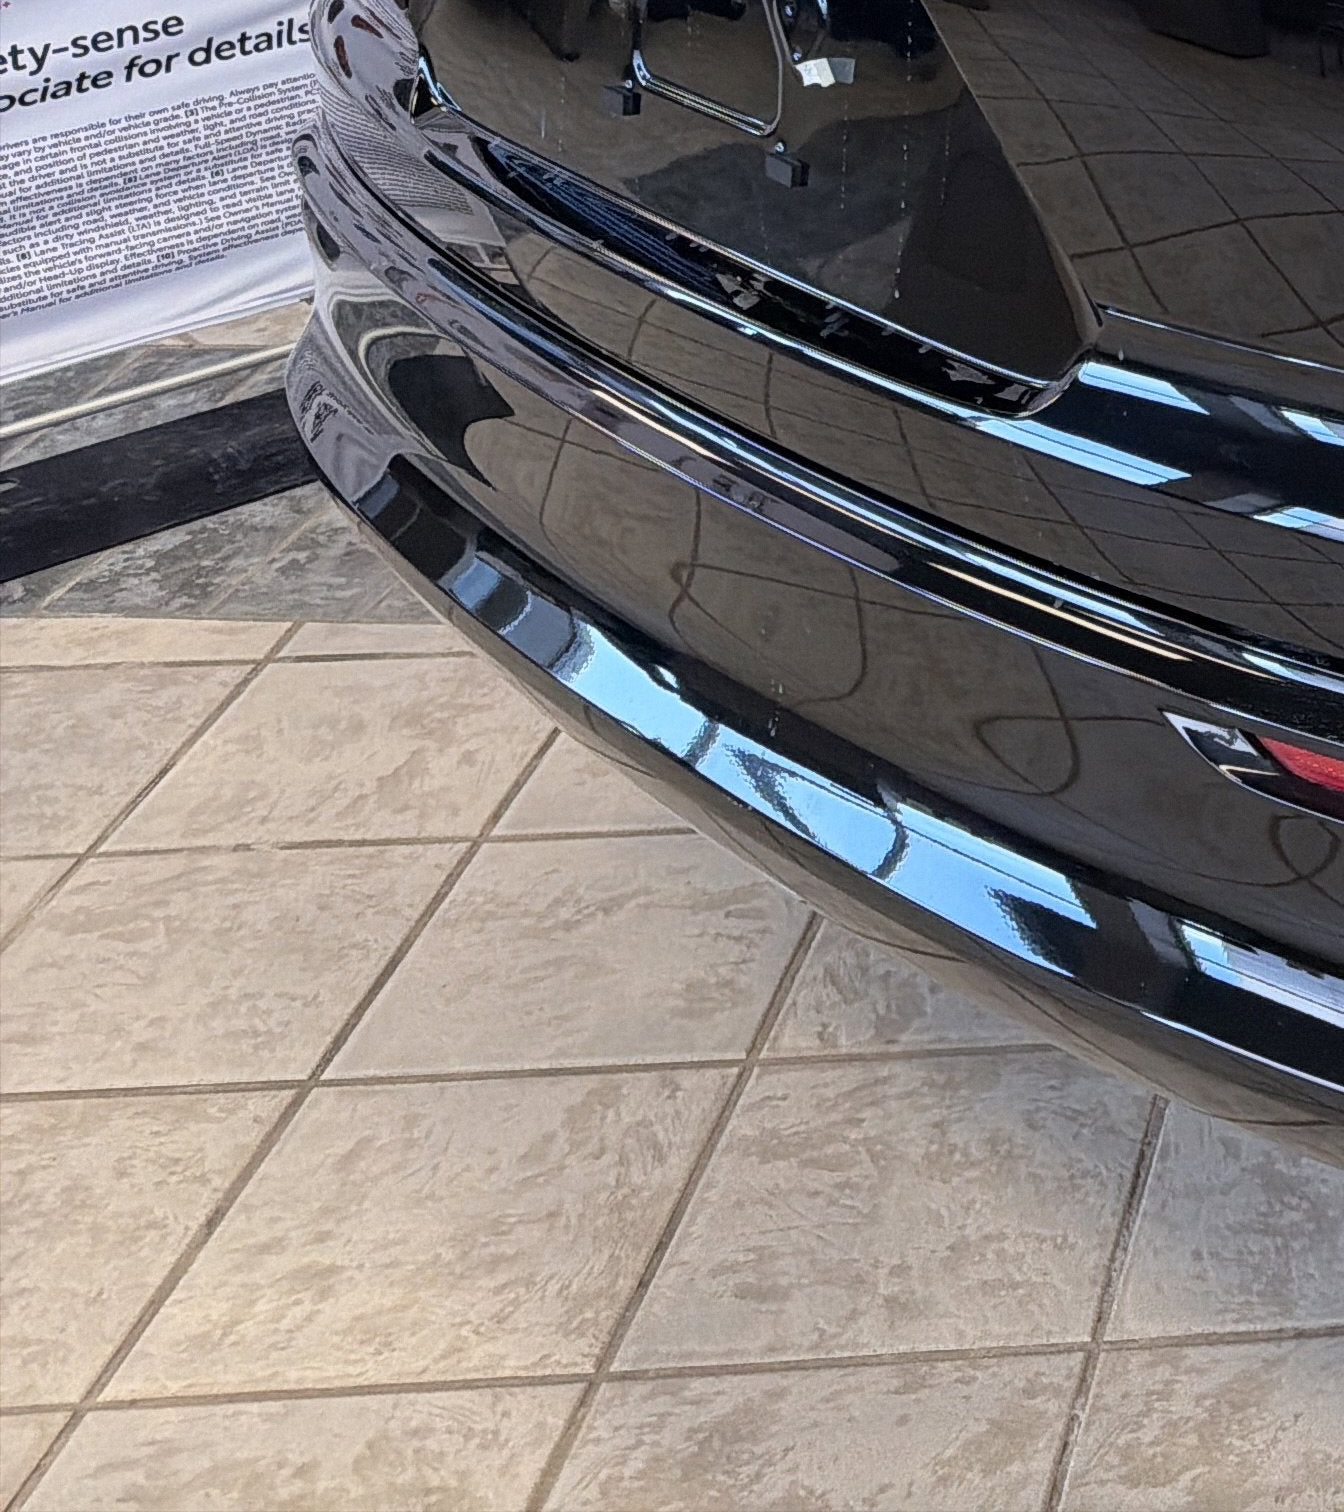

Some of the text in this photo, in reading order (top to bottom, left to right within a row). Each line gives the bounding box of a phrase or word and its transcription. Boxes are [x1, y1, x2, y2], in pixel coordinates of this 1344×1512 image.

[0, 15, 184, 76] ety-sense
[0, 18, 310, 113] ociate for details
